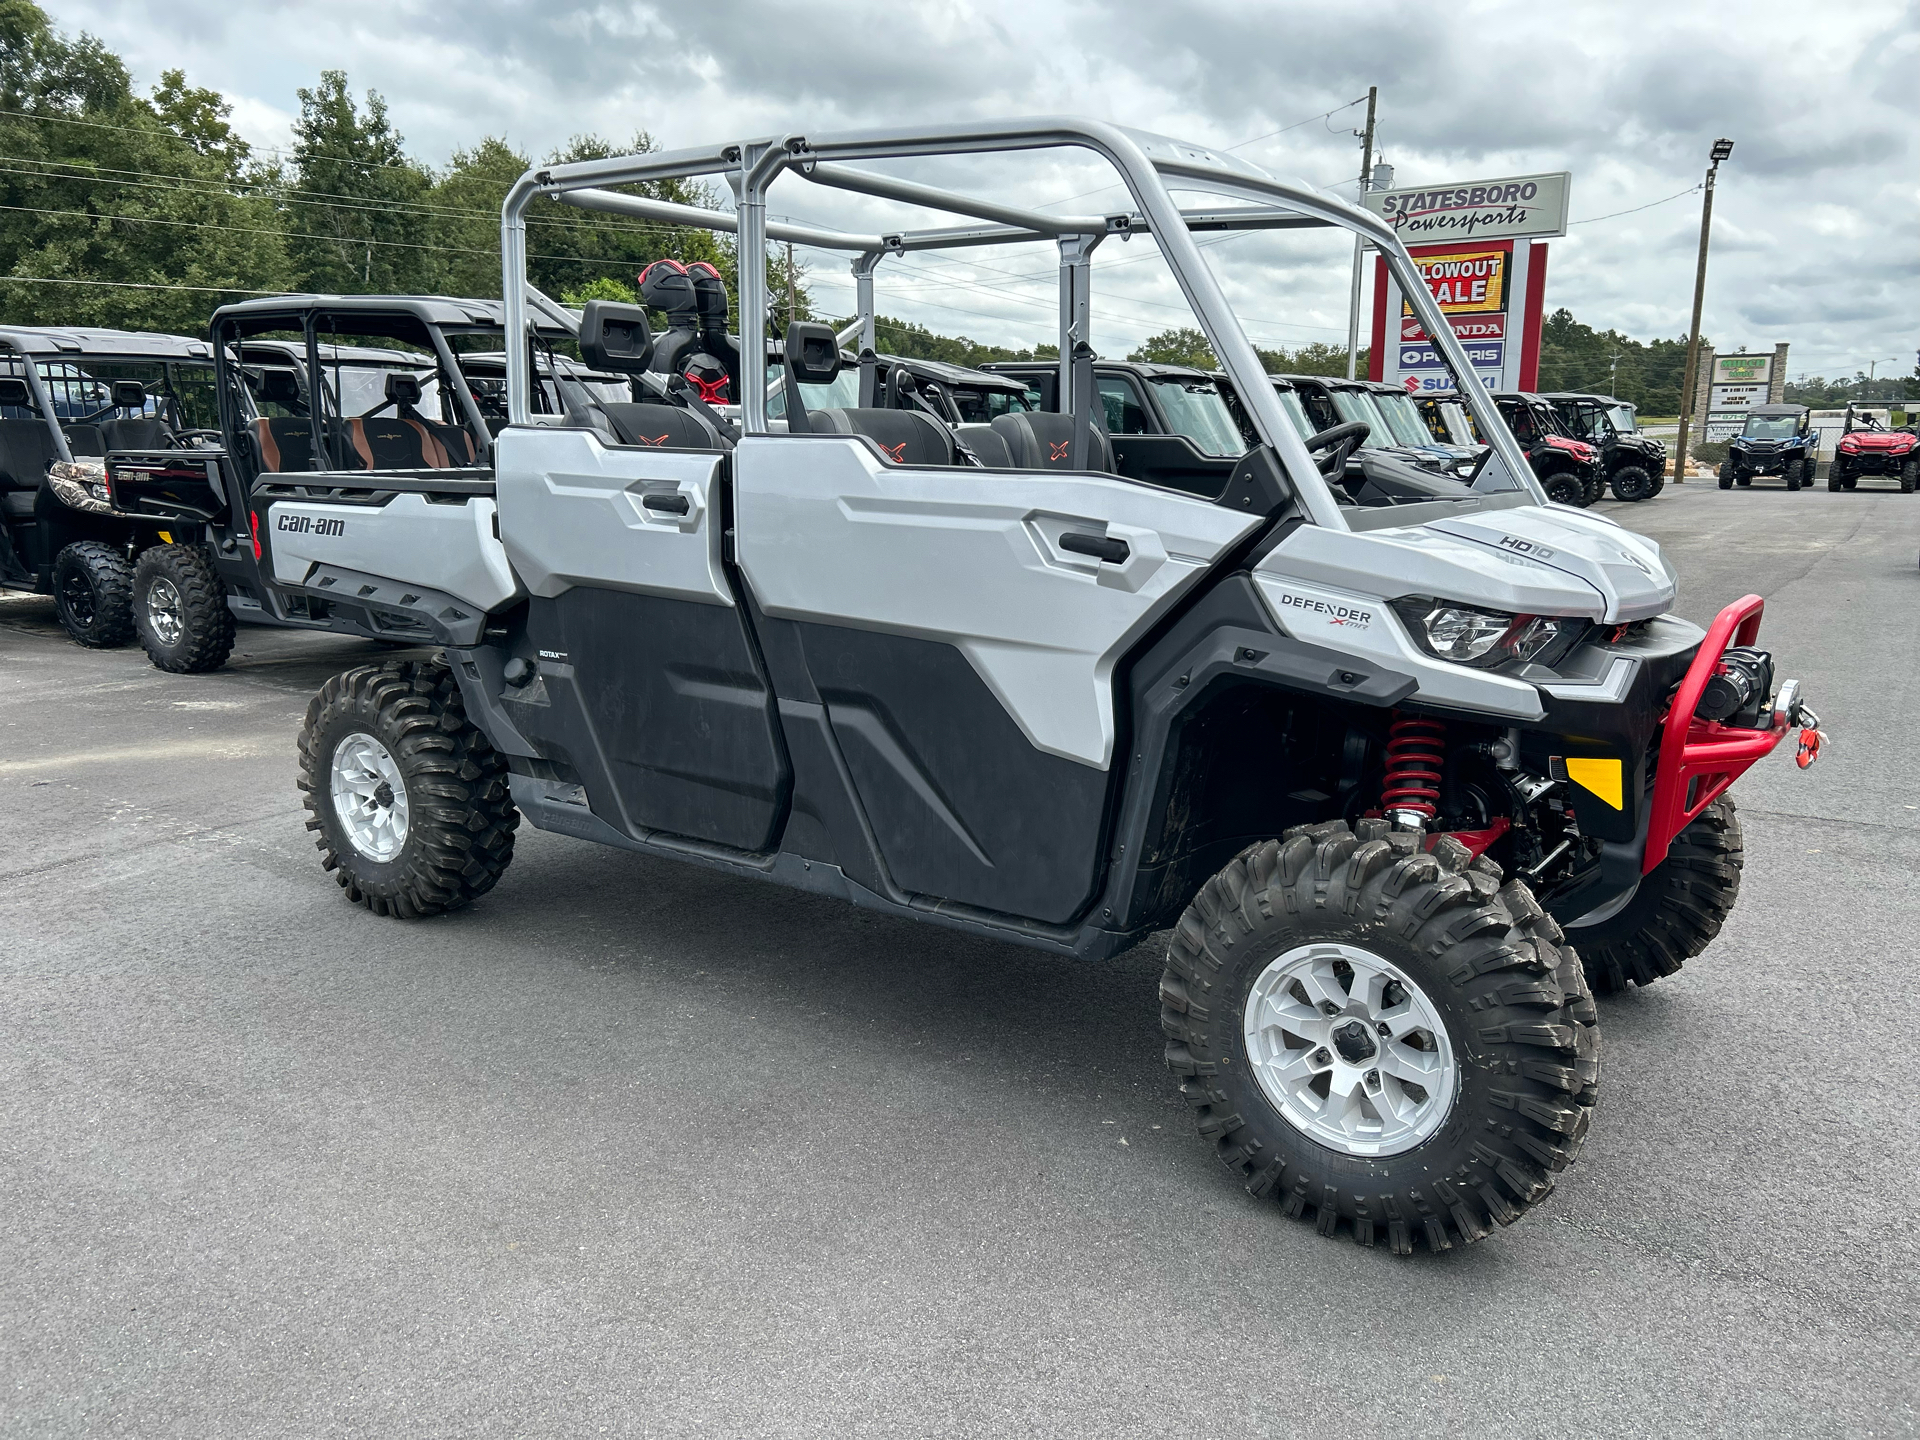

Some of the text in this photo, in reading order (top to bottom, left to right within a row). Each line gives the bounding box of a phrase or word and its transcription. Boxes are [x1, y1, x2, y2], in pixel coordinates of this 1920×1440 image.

[1382, 182, 1538, 214] STATESBORO
[1394, 204, 1527, 234] Powersports
[1720, 359, 1766, 367] MULCH
[117, 471, 150, 481] can-am
[277, 514, 345, 536] can-am
[1499, 535, 1555, 559] HD10
[1281, 594, 1371, 623] DEFENDER
[539, 650, 560, 659] ROTAX
